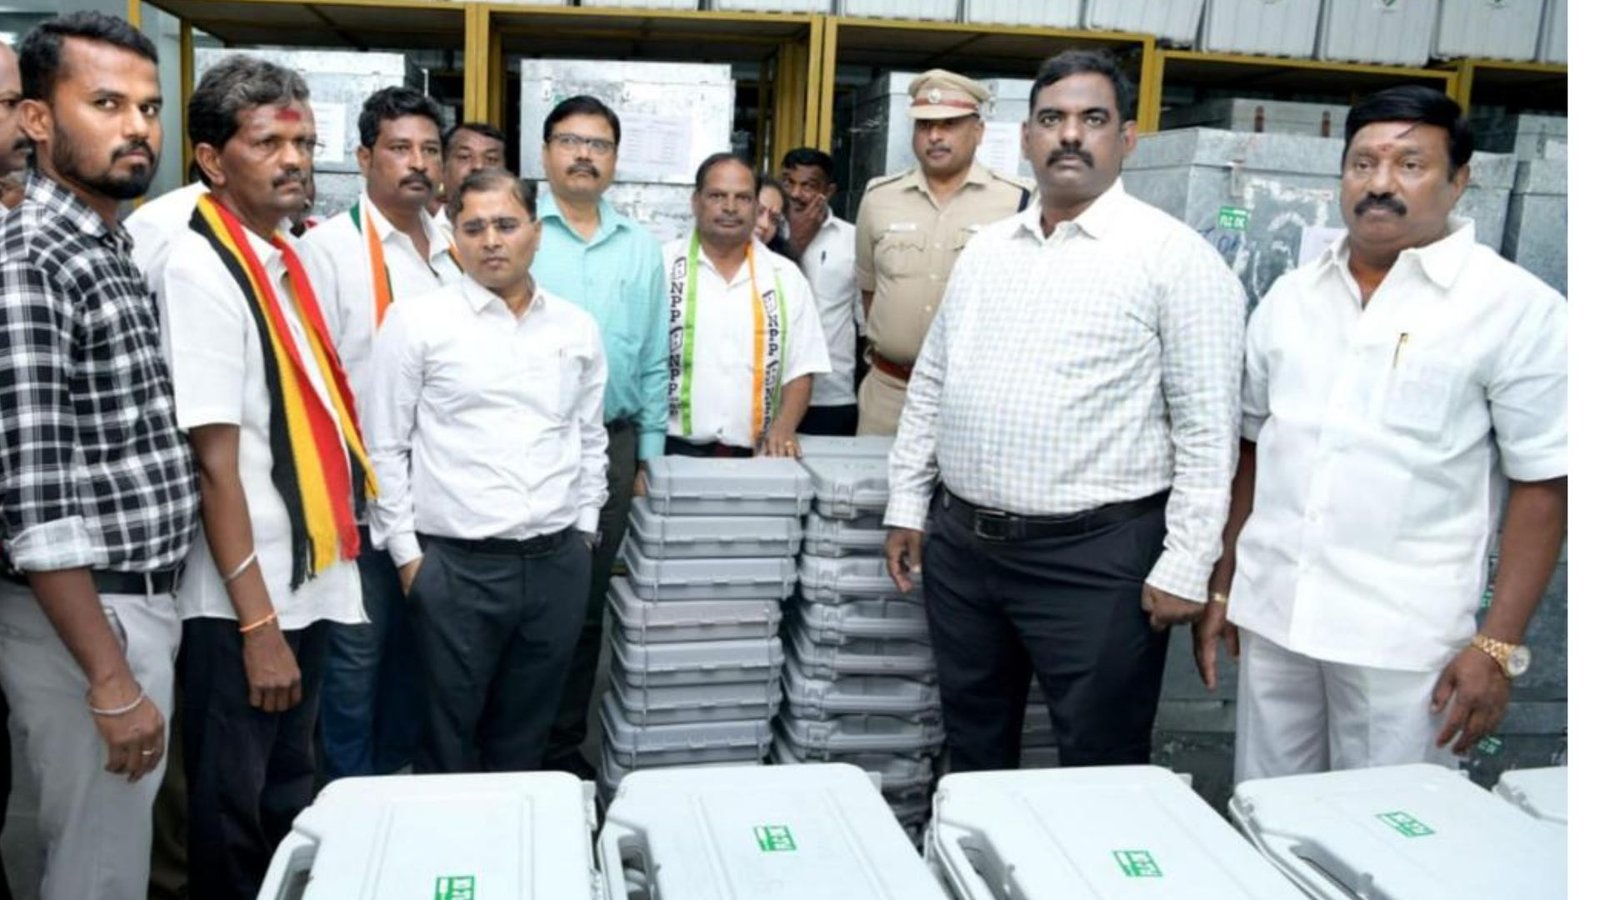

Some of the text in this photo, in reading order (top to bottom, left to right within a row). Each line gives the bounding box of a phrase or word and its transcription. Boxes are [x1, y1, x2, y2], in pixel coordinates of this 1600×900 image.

[670, 281, 683, 322] NPP
[768, 314, 778, 356] NPP
[668, 353, 680, 395] NPP
